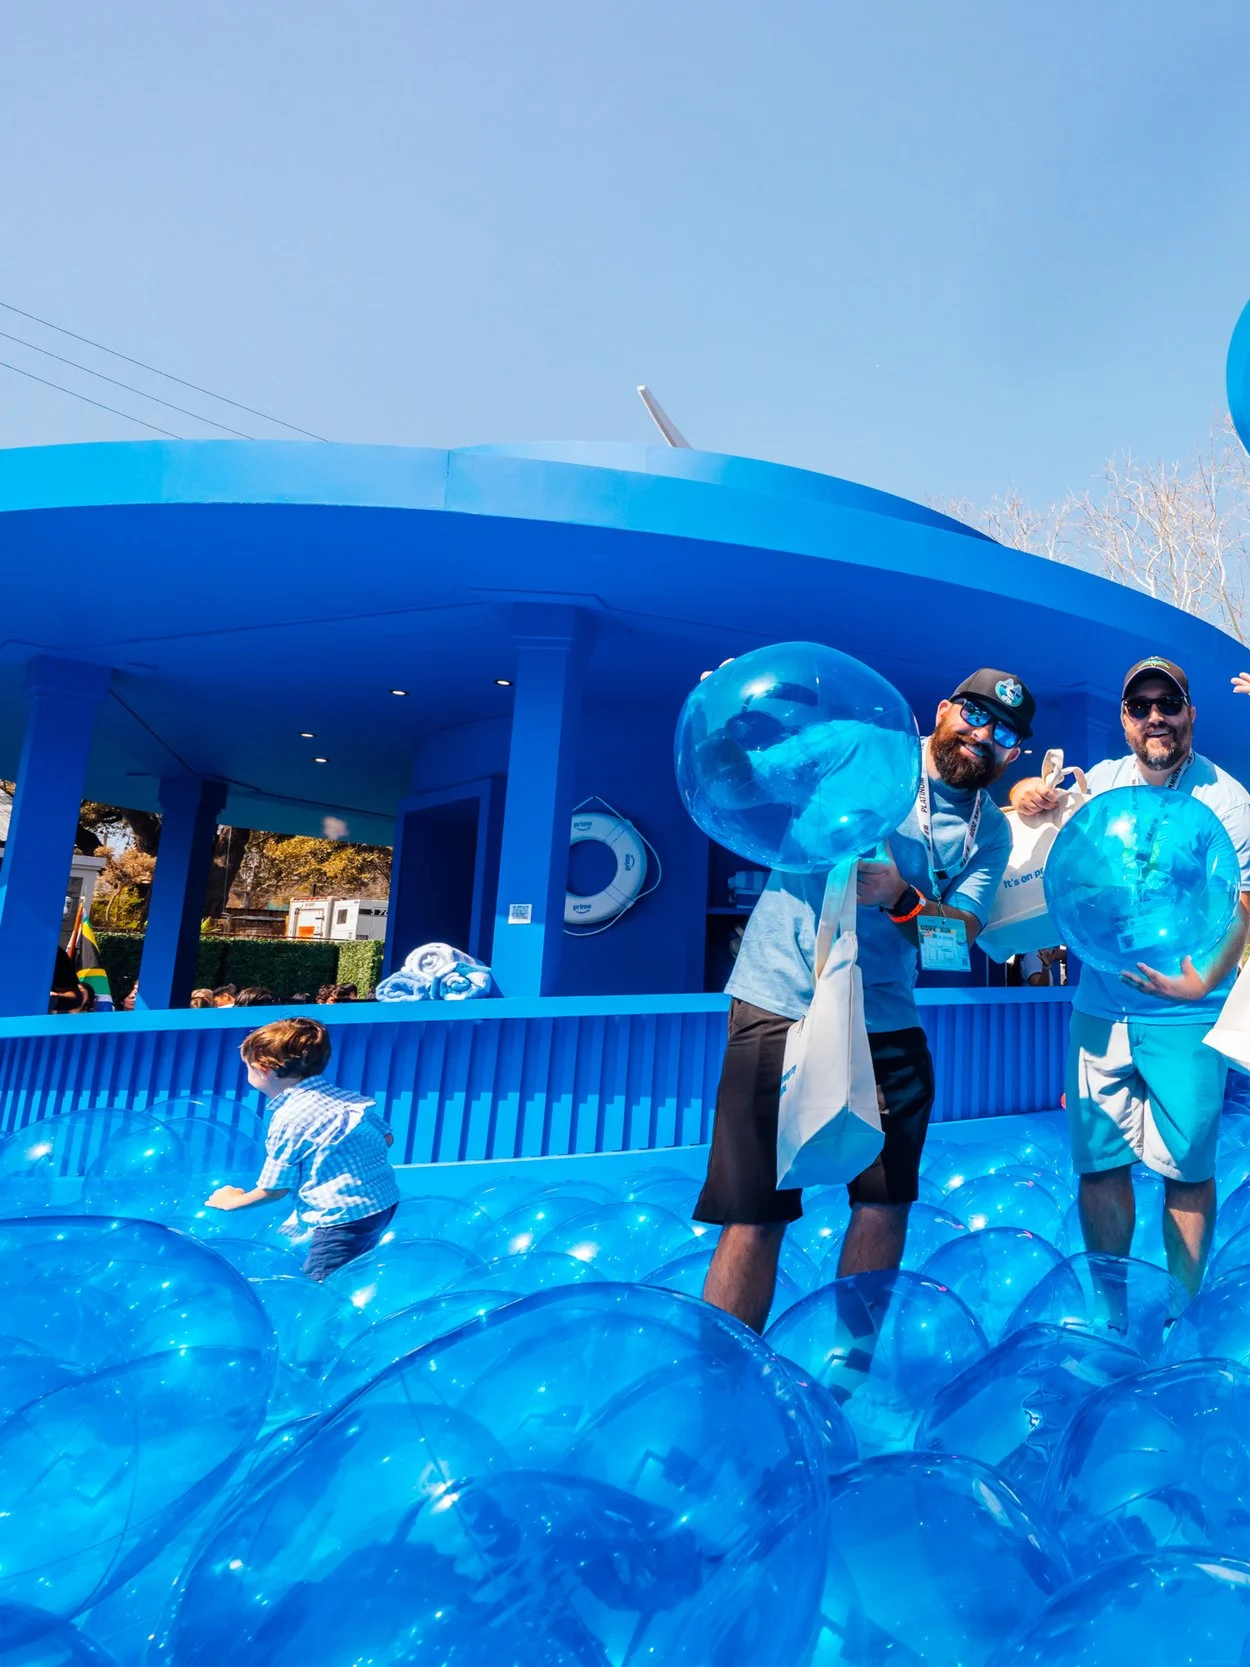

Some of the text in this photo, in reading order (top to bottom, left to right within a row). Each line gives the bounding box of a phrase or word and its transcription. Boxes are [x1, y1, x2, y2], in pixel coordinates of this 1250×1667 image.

[918, 778, 928, 813] PLATINUM
[573, 820, 593, 828] prime
[1003, 878, 1020, 888] It's
[1021, 873, 1033, 883] on
[572, 903, 592, 911] prime
